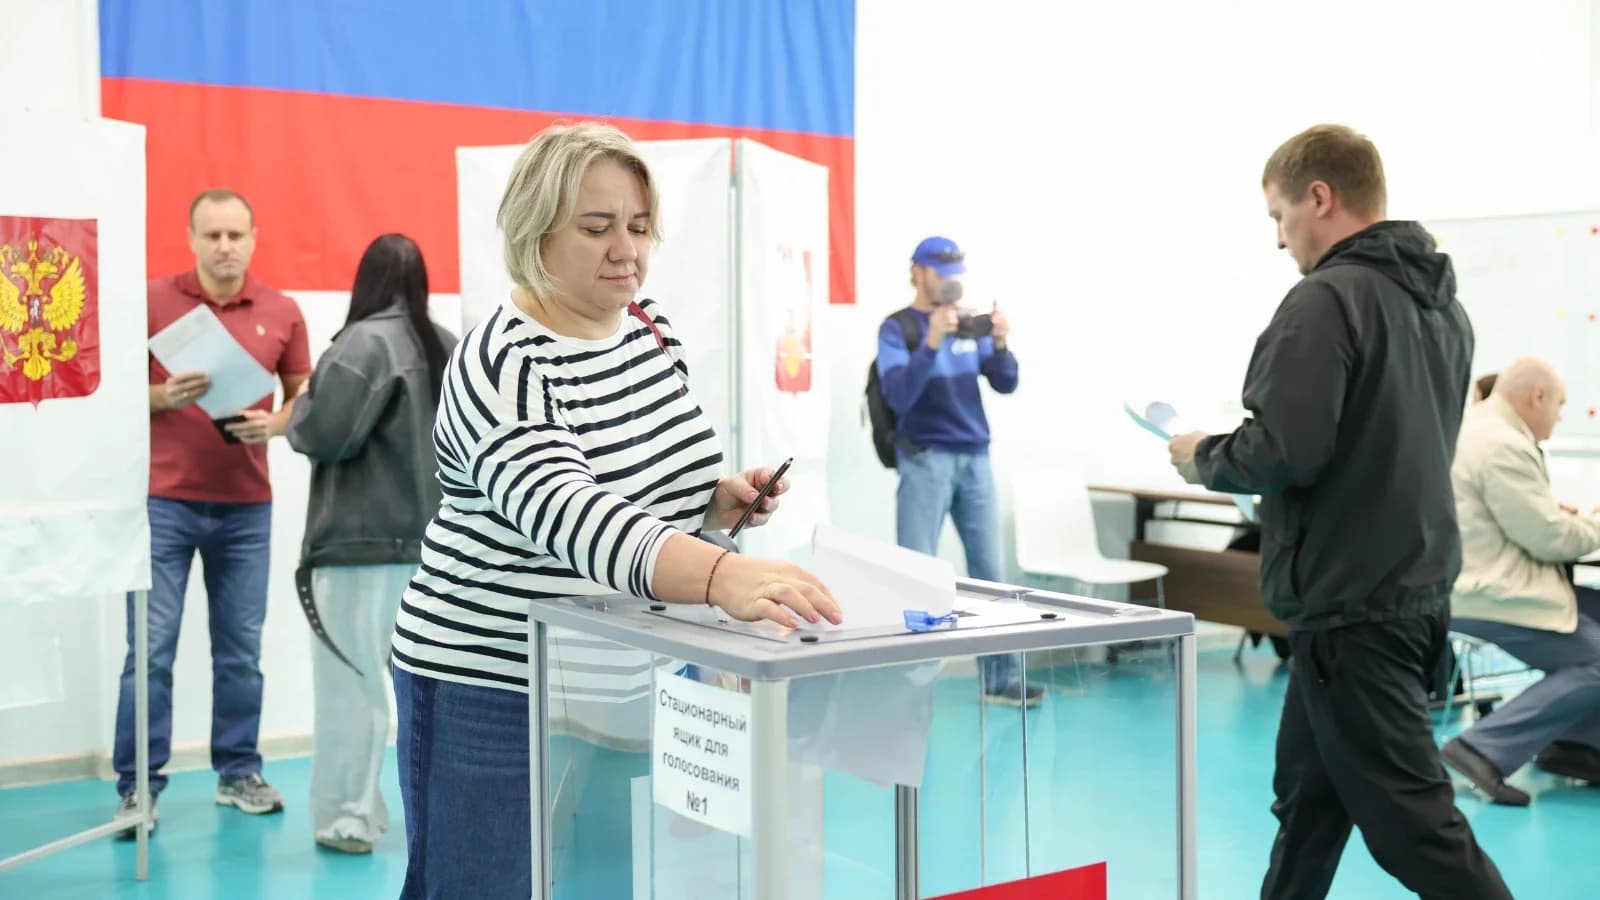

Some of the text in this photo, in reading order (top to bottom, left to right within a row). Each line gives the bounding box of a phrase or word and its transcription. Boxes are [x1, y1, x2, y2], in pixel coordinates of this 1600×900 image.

[659, 689, 747, 732] Стационарный
[673, 727, 728, 757] ящик для
[663, 752, 740, 791] голосования
[686, 790, 708, 816] №1
